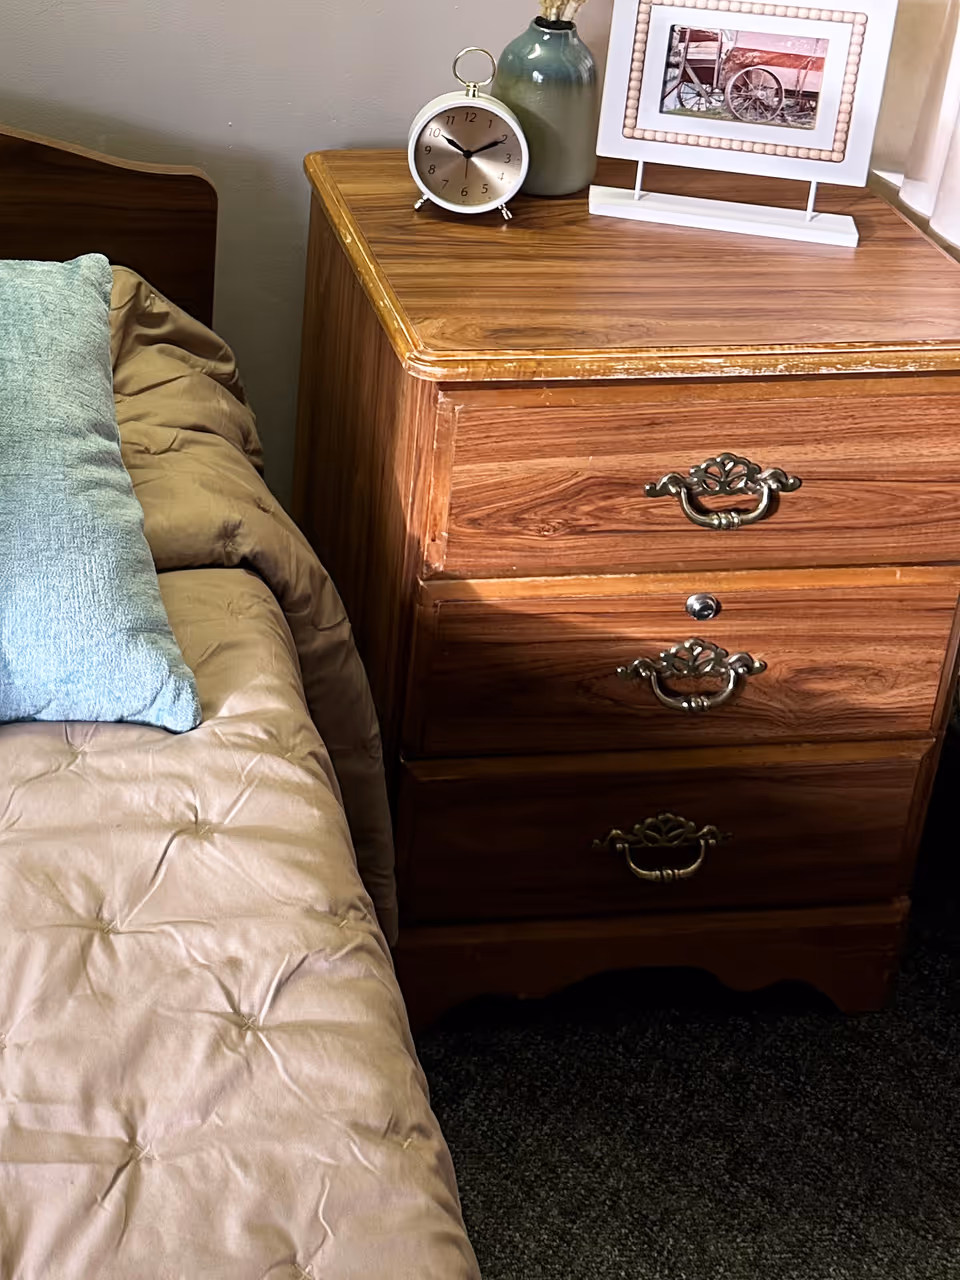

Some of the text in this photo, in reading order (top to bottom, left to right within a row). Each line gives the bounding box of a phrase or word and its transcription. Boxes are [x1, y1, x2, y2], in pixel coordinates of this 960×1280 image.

[445, 116, 456, 125] 11
[464, 112, 477, 123] 12
[487, 120, 493, 129] 1
[428, 128, 441, 138] 10
[499, 134, 508, 144] 2
[424, 146, 432, 155] 9
[504, 153, 512, 163] 3
[428, 164, 436, 175] 8
[441, 179, 449, 190] 7
[481, 184, 489, 194] 5
[460, 187, 468, 197] 6
